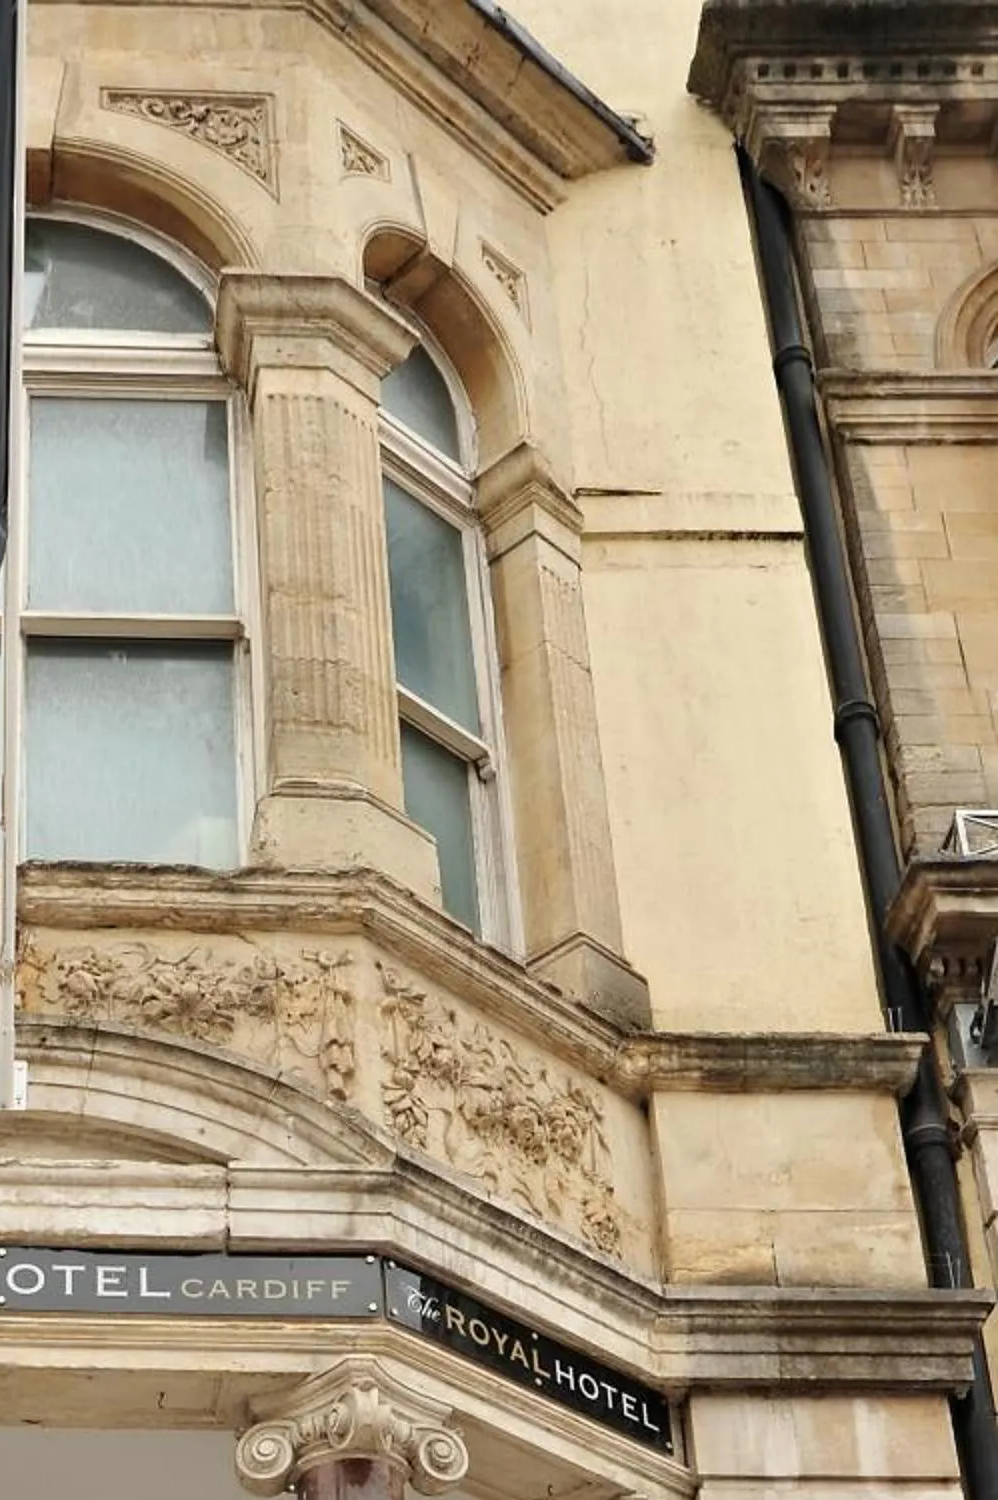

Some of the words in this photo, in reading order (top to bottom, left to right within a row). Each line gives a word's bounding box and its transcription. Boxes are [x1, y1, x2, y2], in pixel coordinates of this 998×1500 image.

[181, 1277, 351, 1299] CARDIFF
[401, 1284, 441, 1322] The
[445, 1304, 551, 1379] ROYAL
[554, 1359, 660, 1433] HOTEL
